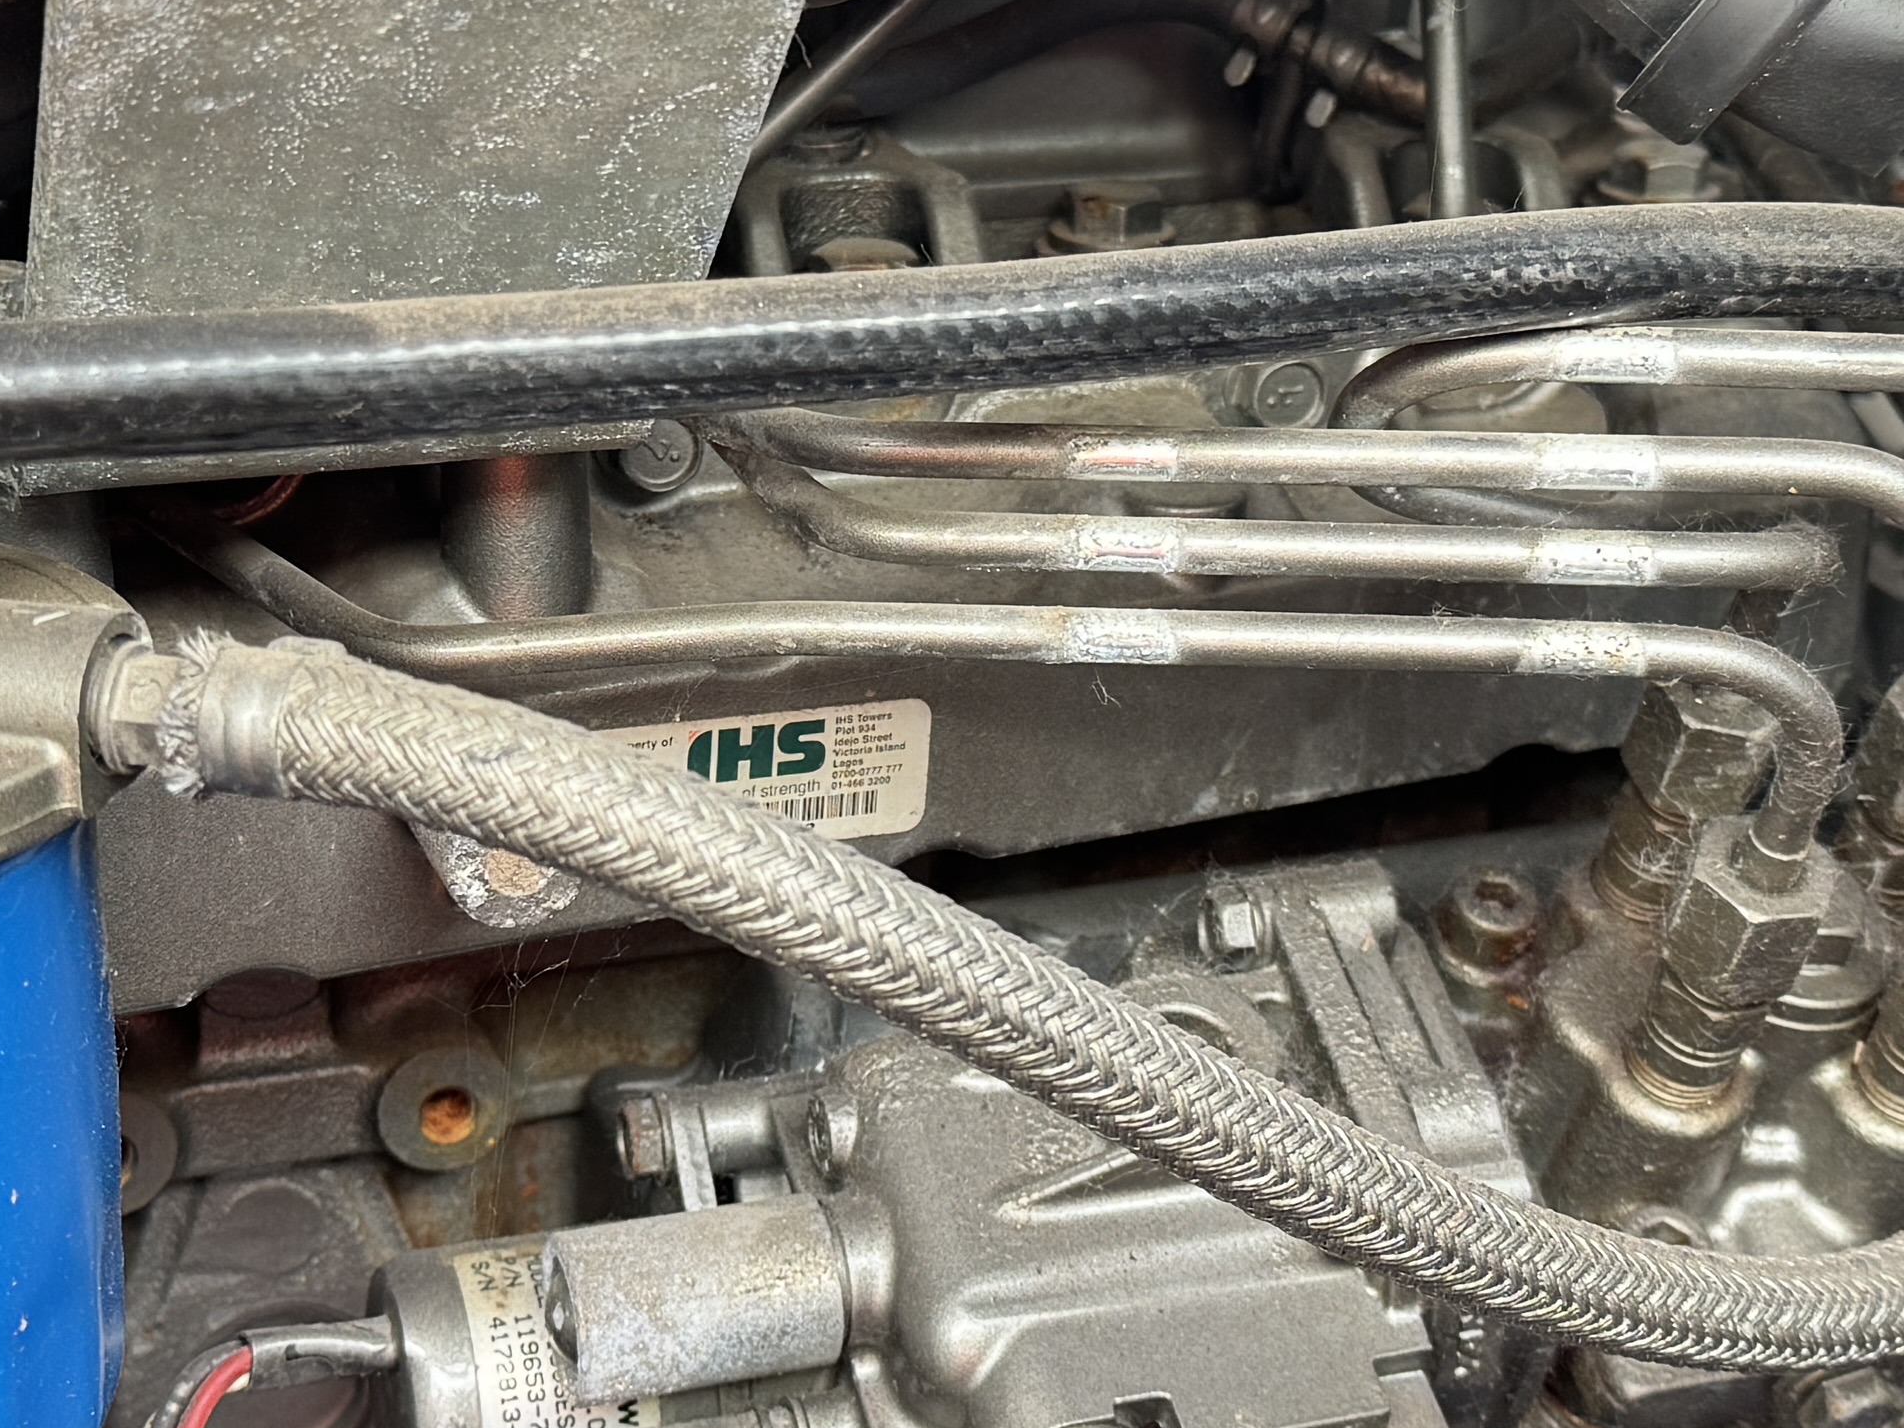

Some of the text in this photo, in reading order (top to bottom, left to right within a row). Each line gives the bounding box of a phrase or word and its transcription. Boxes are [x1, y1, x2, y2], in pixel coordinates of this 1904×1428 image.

[835, 712, 893, 725] IHS Towers
[835, 723, 876, 735] Plot 934
[834, 732, 893, 747] Idejo Street
[687, 719, 826, 783] IHS
[832, 740, 906, 757] Victoria Island
[833, 758, 864, 769] Lagos
[886, 763, 903, 773] 777
[760, 779, 821, 798] strength
[471, 1260, 498, 1292] S/N
[503, 1256, 524, 1289] P/N
